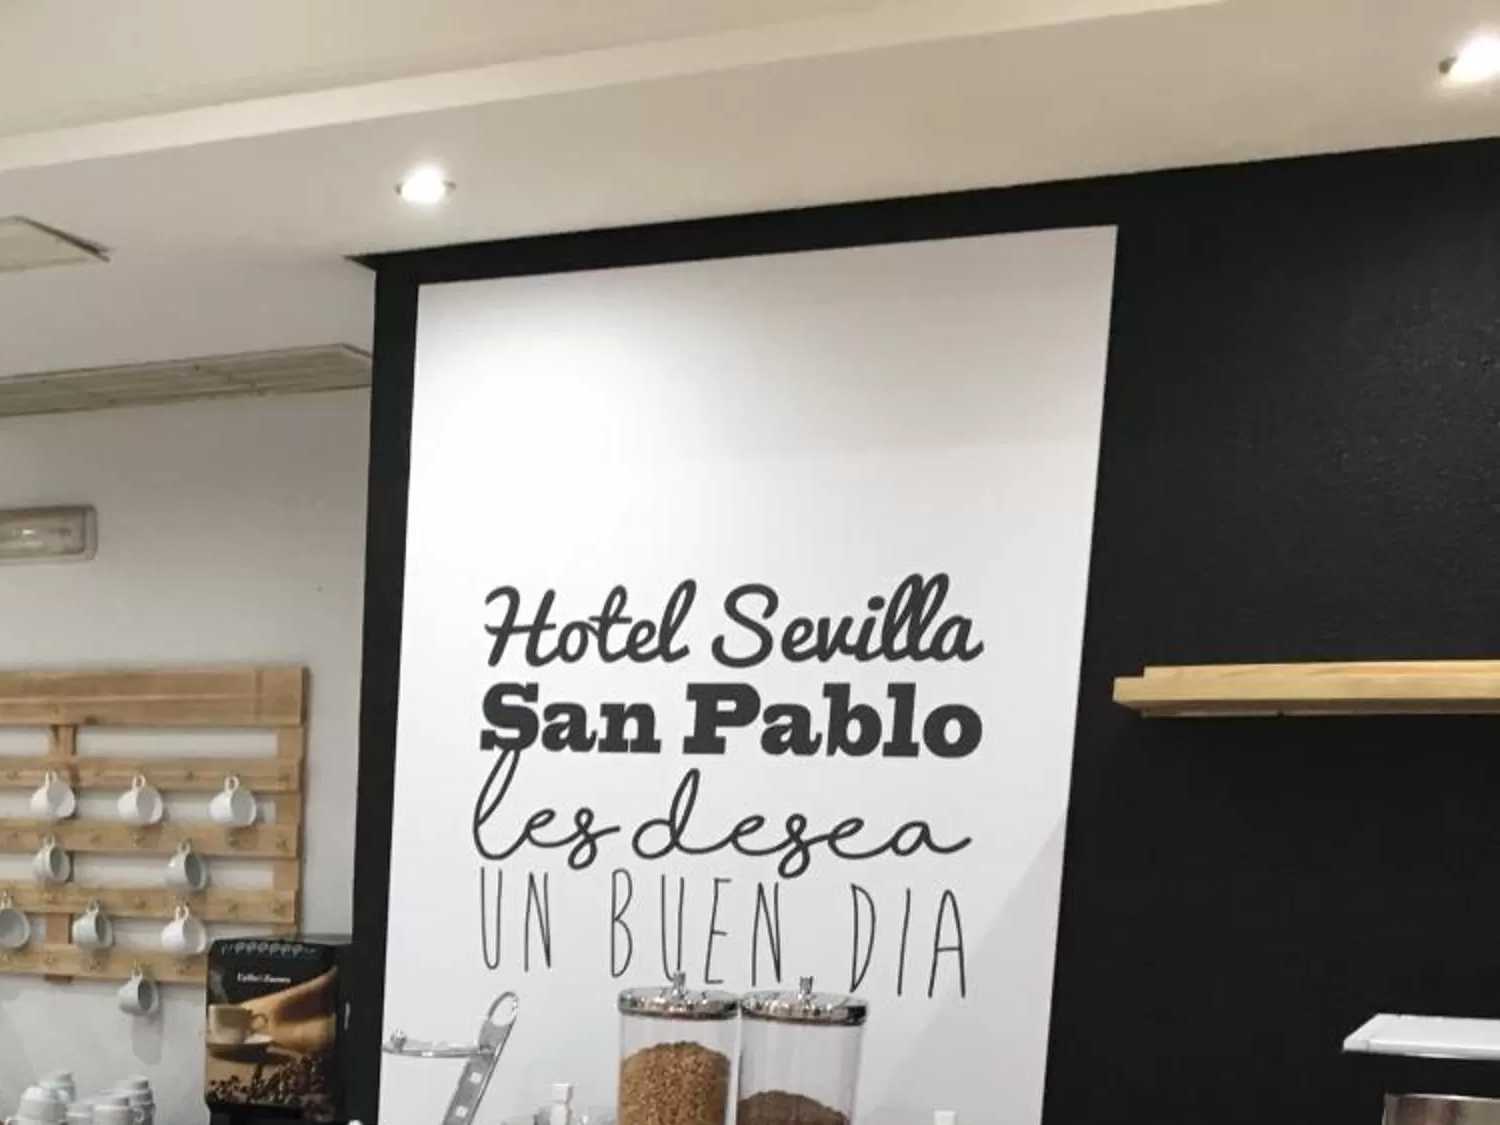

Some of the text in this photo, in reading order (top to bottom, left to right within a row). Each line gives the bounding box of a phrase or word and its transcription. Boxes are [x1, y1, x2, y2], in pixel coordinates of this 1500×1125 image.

[484, 573, 985, 669] Hotel Sevilla
[480, 682, 983, 759] San Pablo
[473, 748, 973, 879] les desea
[480, 867, 967, 999] UN BUEN DIA
